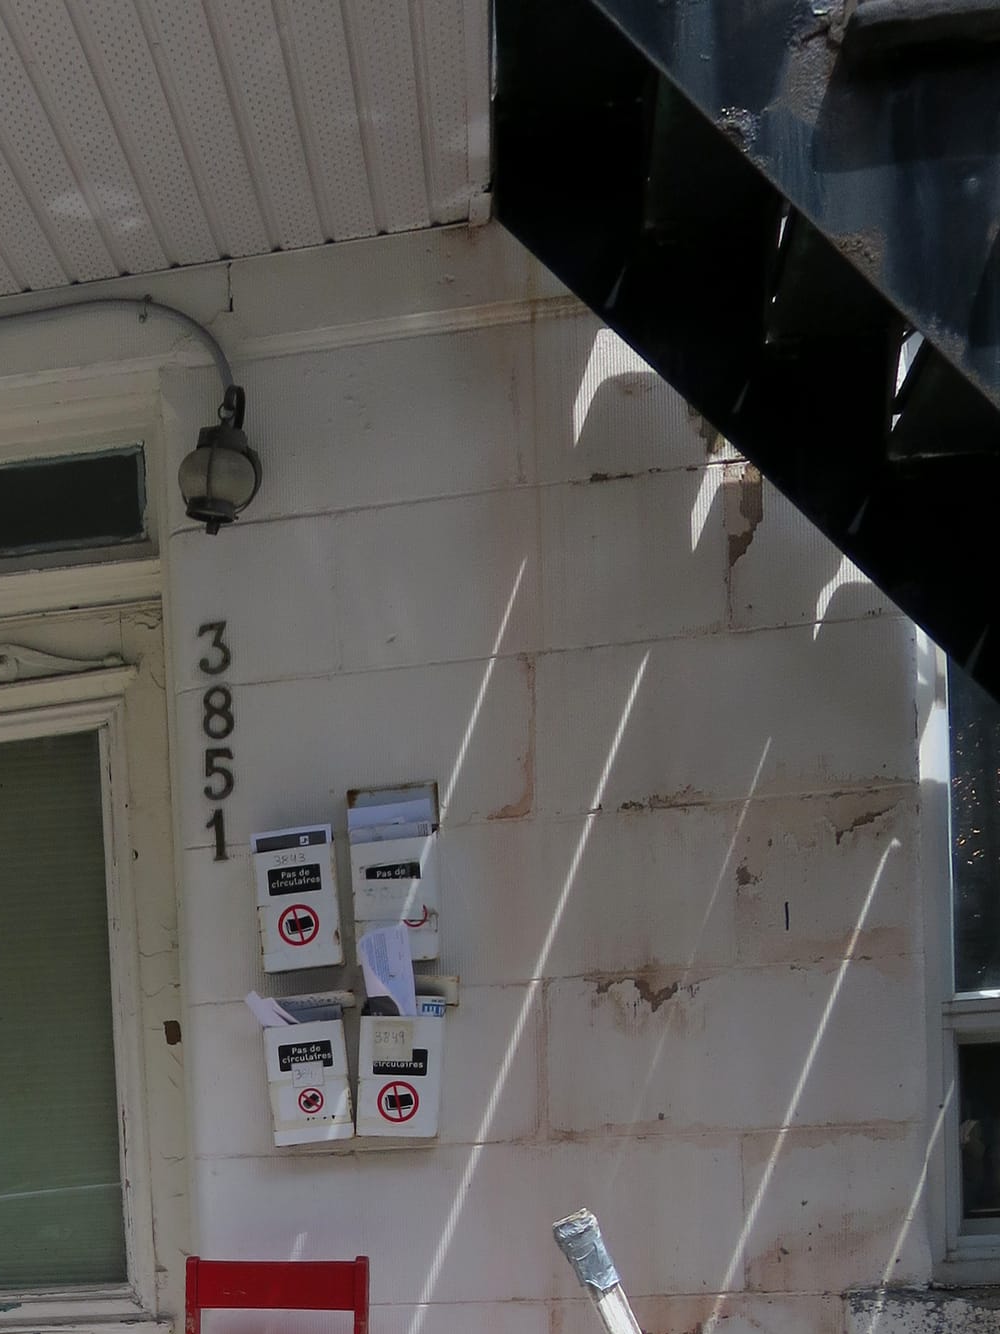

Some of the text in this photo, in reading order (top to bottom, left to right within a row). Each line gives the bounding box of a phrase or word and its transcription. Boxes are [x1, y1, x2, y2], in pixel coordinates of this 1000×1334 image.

[198, 620, 235, 861] 3851
[281, 868, 310, 879] Pas de
[376, 870, 392, 878] Pas
[394, 867, 406, 876] de
[271, 876, 321, 889] circulaires
[291, 1044, 321, 1055] Pas de
[282, 1052, 332, 1064] circulaires
[373, 1060, 424, 1069] circulaires
